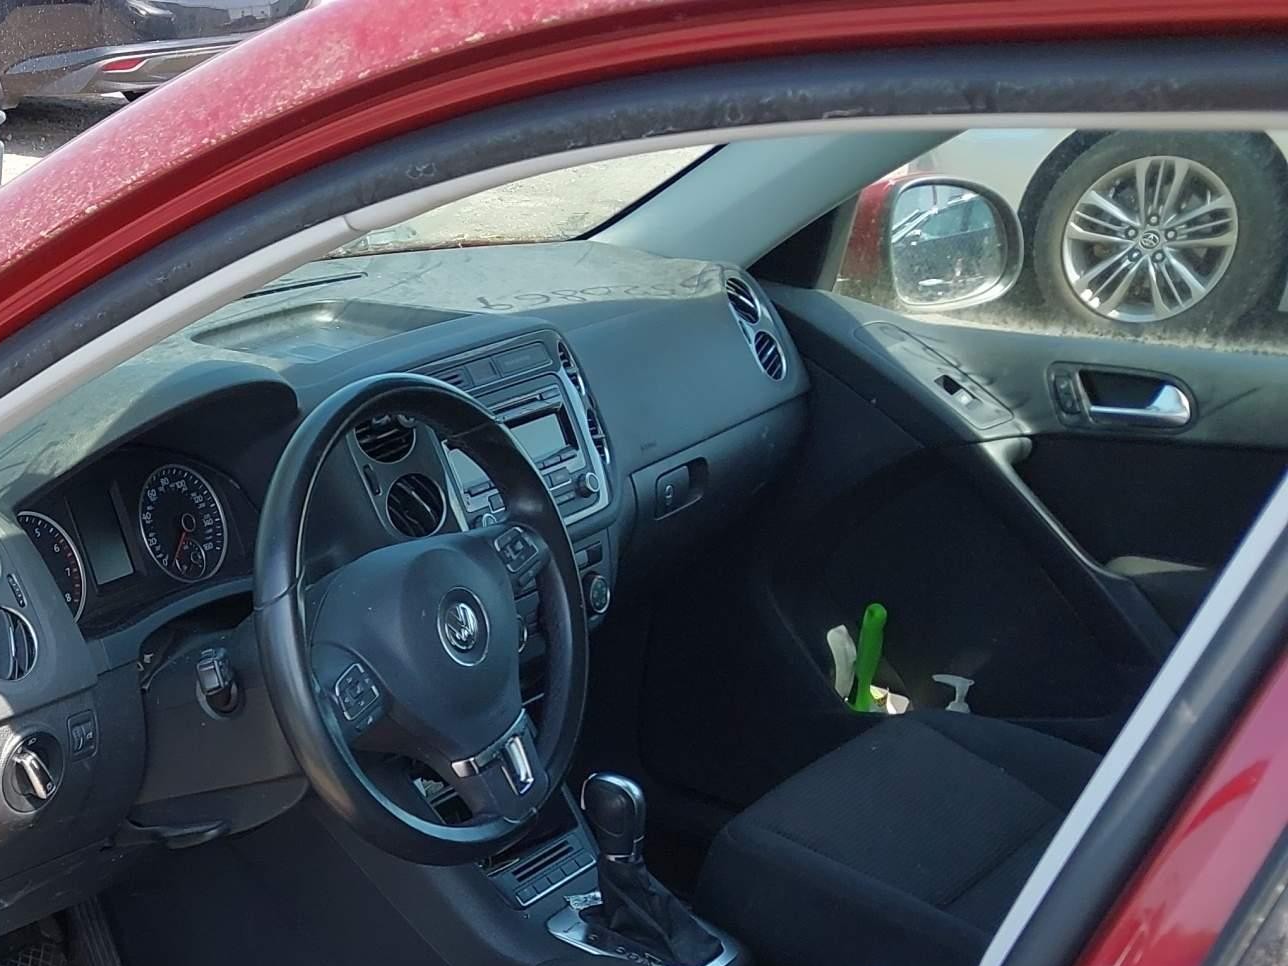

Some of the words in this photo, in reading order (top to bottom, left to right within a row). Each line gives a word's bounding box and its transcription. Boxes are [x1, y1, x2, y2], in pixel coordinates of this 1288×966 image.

[34, 528, 41, 538] 5
[53, 544, 60, 553] 6
[65, 567, 71, 577] 7
[65, 593, 72, 602] 8
